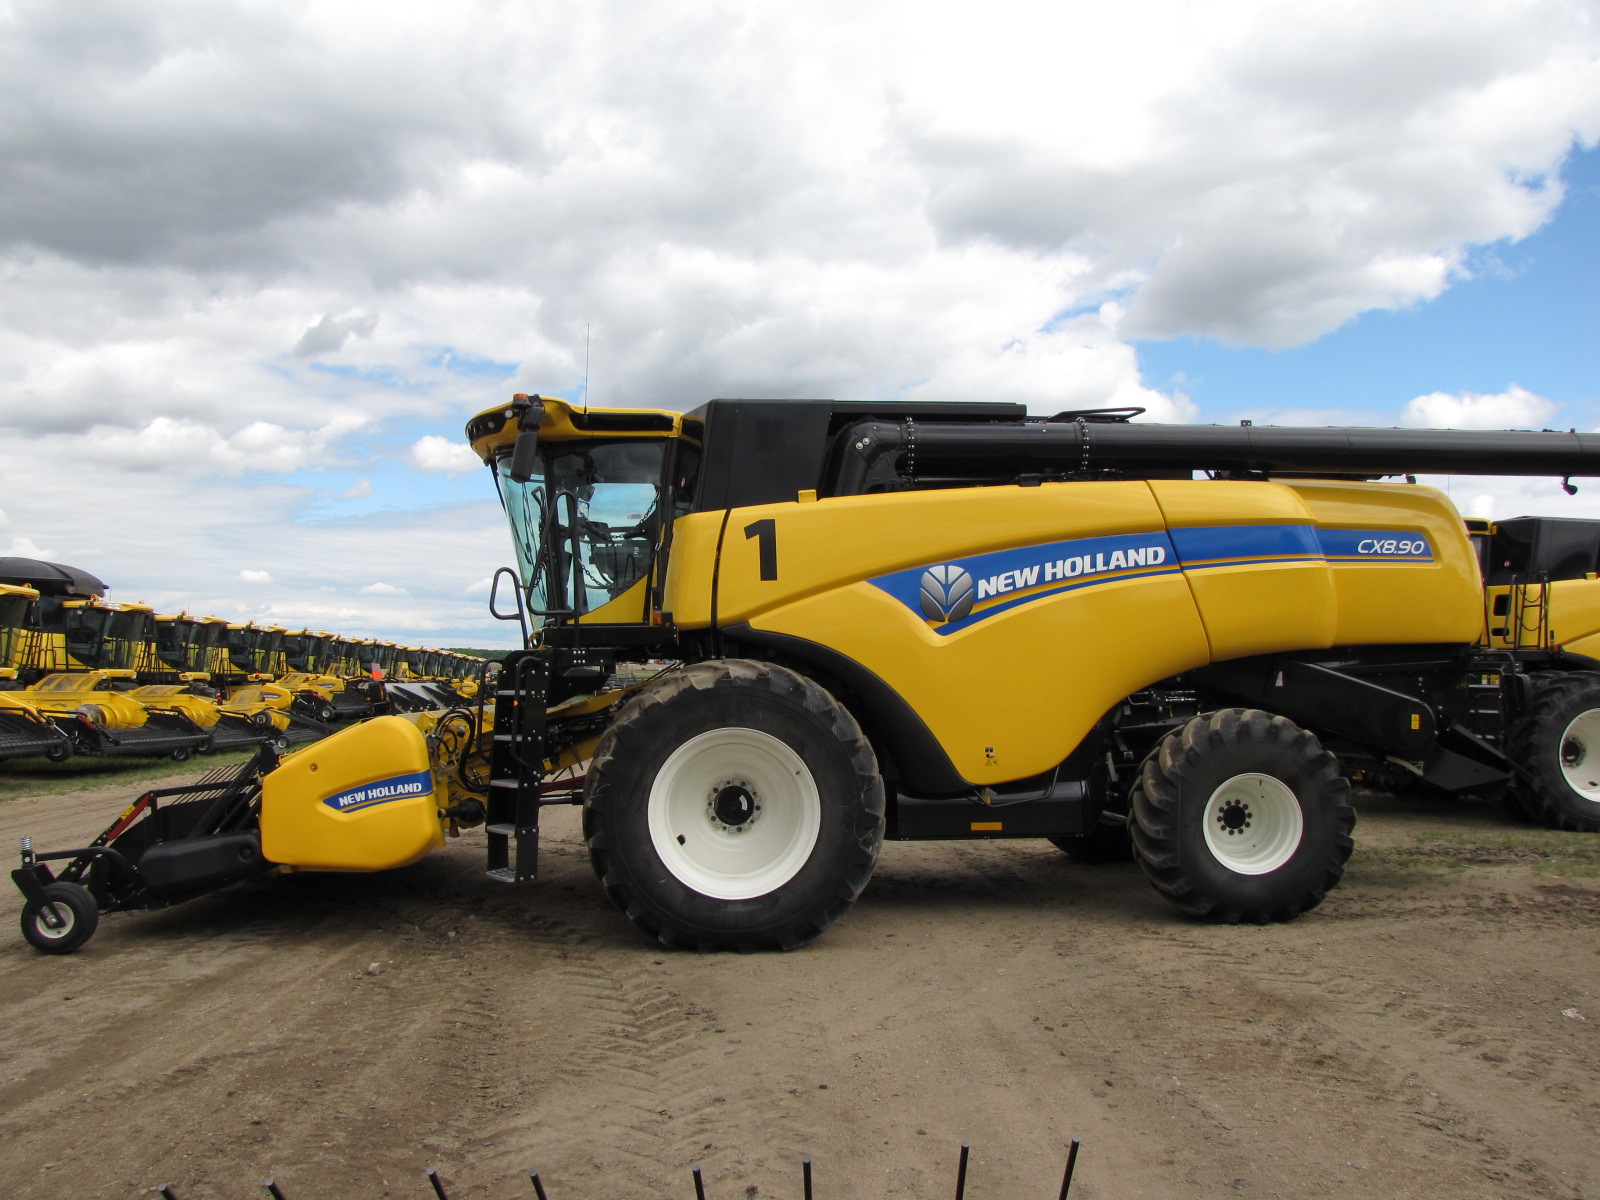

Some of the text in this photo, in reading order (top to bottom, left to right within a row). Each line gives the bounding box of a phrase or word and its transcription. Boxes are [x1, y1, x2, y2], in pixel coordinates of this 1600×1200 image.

[743, 518, 778, 581] 1
[1357, 539, 1425, 555] CX8.90
[978, 546, 1166, 599] NEW HOLLAND
[338, 782, 422, 807] NEW HOLLAND
